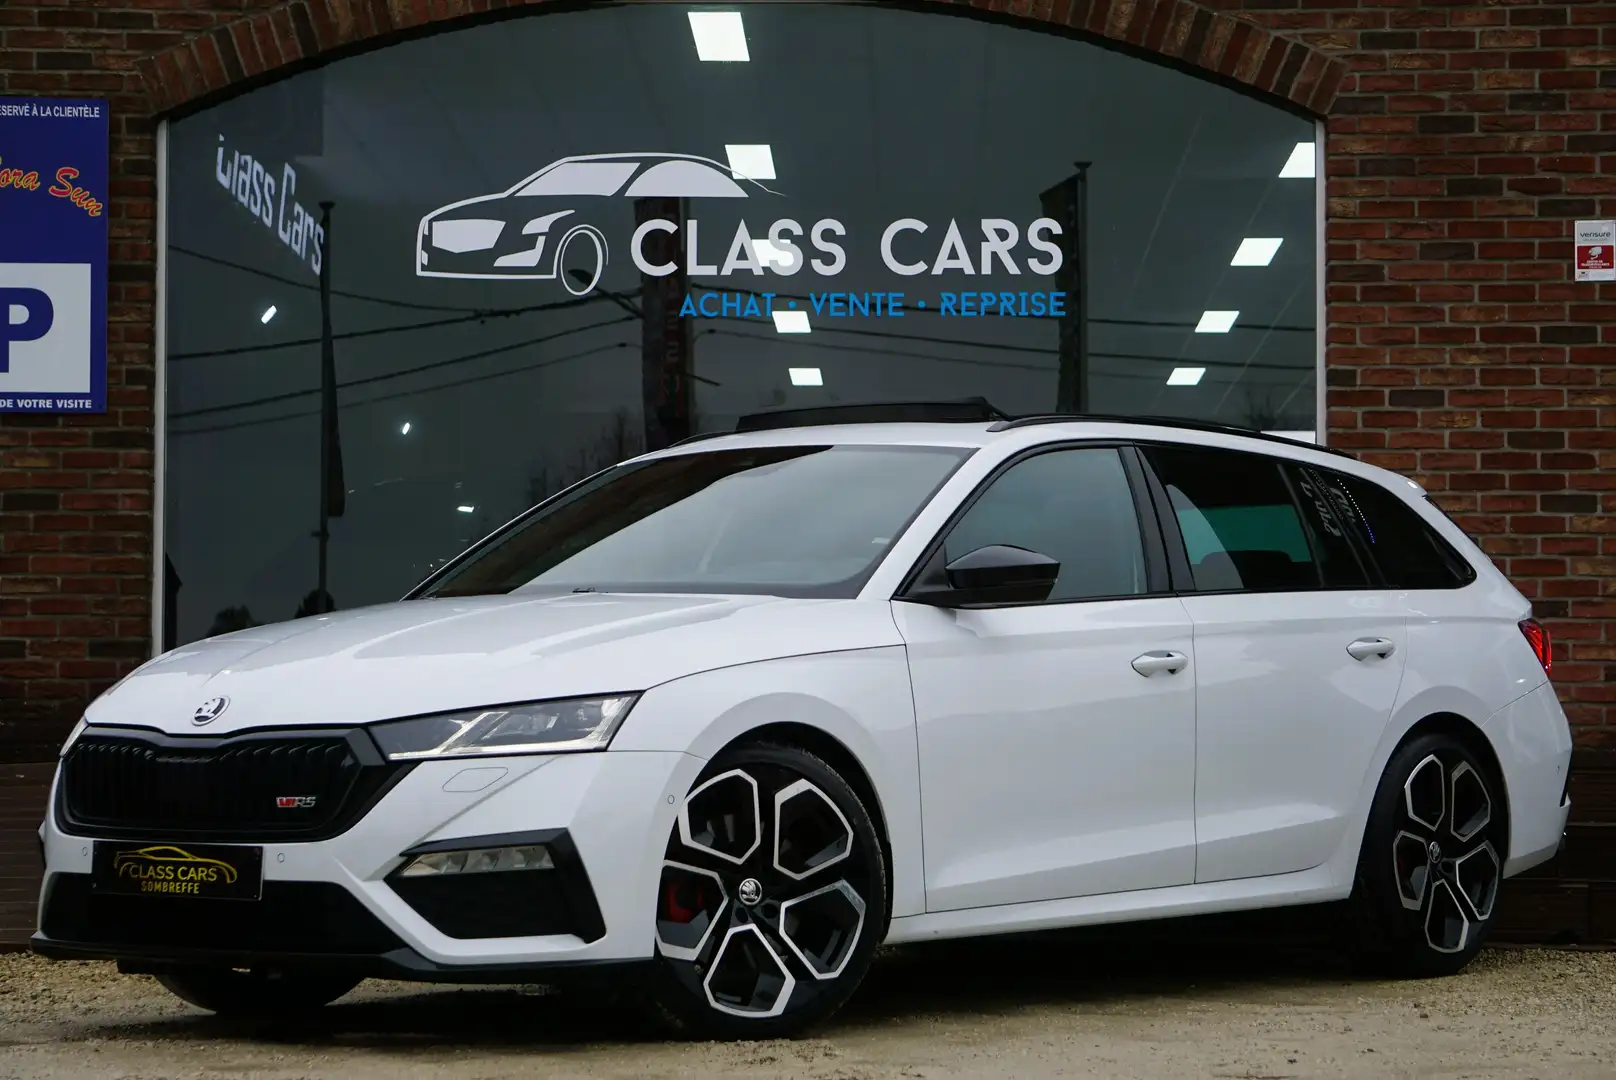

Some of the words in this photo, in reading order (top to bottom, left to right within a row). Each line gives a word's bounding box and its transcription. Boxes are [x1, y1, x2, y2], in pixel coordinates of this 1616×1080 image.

[32, 104, 38, 116] À
[41, 106, 52, 116] LA
[53, 105, 100, 117] CLIENTÈLE
[48, 167, 103, 216] Sun
[278, 162, 324, 276] Cars
[631, 218, 846, 277] CLASS
[880, 218, 1063, 276] CARS
[679, 293, 776, 317] ACHAT
[809, 292, 905, 317] VENTE
[940, 292, 1066, 317] REPRISE
[0, 287, 54, 373] P
[0, 399, 13, 408] DE
[16, 399, 53, 409] VOTRE
[56, 399, 92, 409] VISITE
[129, 864, 174, 880] CLASS
[177, 866, 218, 882] CARS
[141, 880, 200, 894] SOMBREFFE
